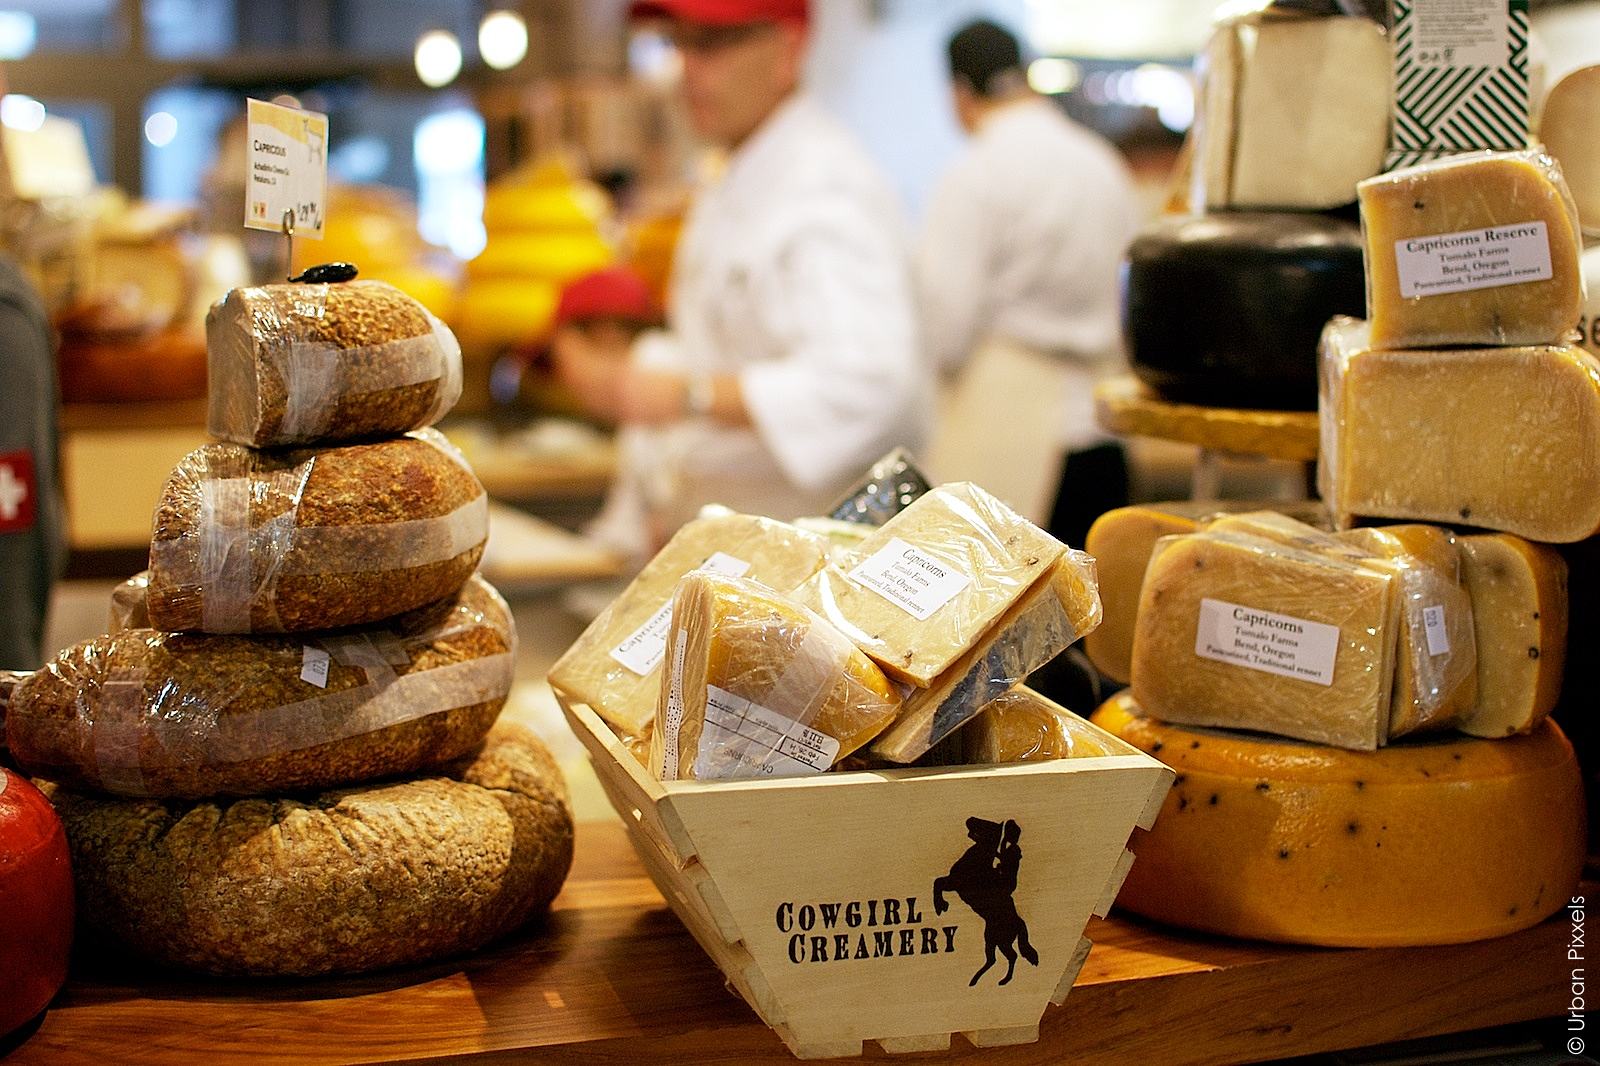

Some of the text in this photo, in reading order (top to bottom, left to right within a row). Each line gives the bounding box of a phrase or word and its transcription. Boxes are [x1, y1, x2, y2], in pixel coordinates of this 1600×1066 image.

[1407, 226, 1538, 254] Capricorns Reserve
[1479, 246, 1510, 257] Farms
[1441, 259, 1510, 275] Bend, Oregon
[902, 548, 947, 578] Capricorns
[896, 578, 919, 595] Oregon
[911, 572, 931, 587] Farms
[618, 602, 673, 653] Capricorn
[1233, 608, 1304, 634] Capricorns
[1234, 639, 1296, 660] Bend, Oregon
[1270, 634, 1299, 647] Farms
[1252, 655, 1295, 672] Traditional
[776, 897, 922, 933] COWGIRL
[788, 926, 958, 964] CREAMERY
